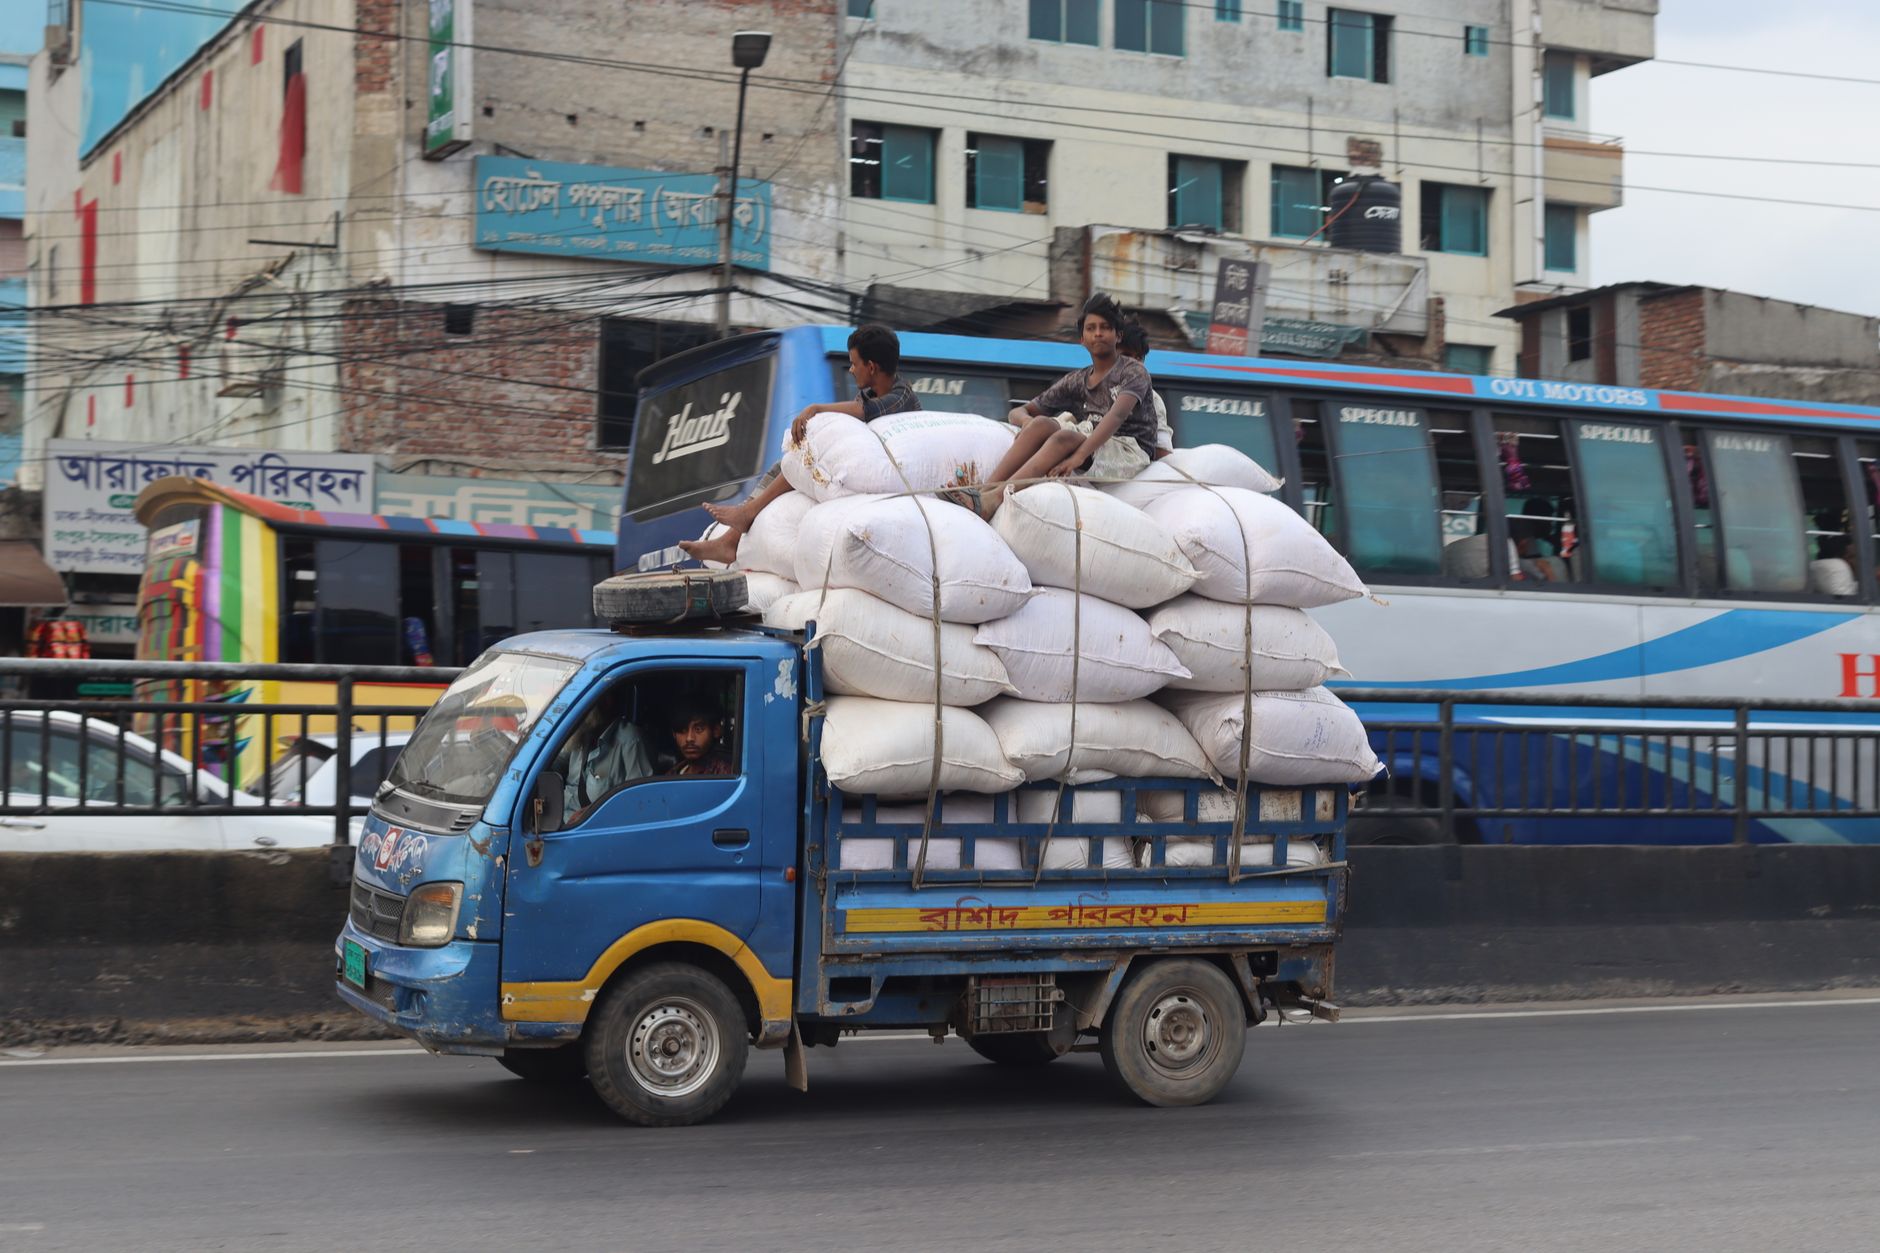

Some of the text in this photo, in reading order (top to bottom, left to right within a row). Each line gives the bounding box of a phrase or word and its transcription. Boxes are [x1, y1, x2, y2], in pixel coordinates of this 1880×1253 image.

[483, 165, 563, 218] হোটেল
[568, 182, 647, 231] পপুলার
[1180, 395, 1266, 417] SPECIAL
[1490, 378, 1649, 407] OVI MOTORS
[1339, 406, 1421, 428] SPECIAL
[1580, 424, 1654, 444] SPECIAL
[230, 452, 368, 504] পরিবহন
[919, 892, 1199, 931] রশিদ পরিবহন
